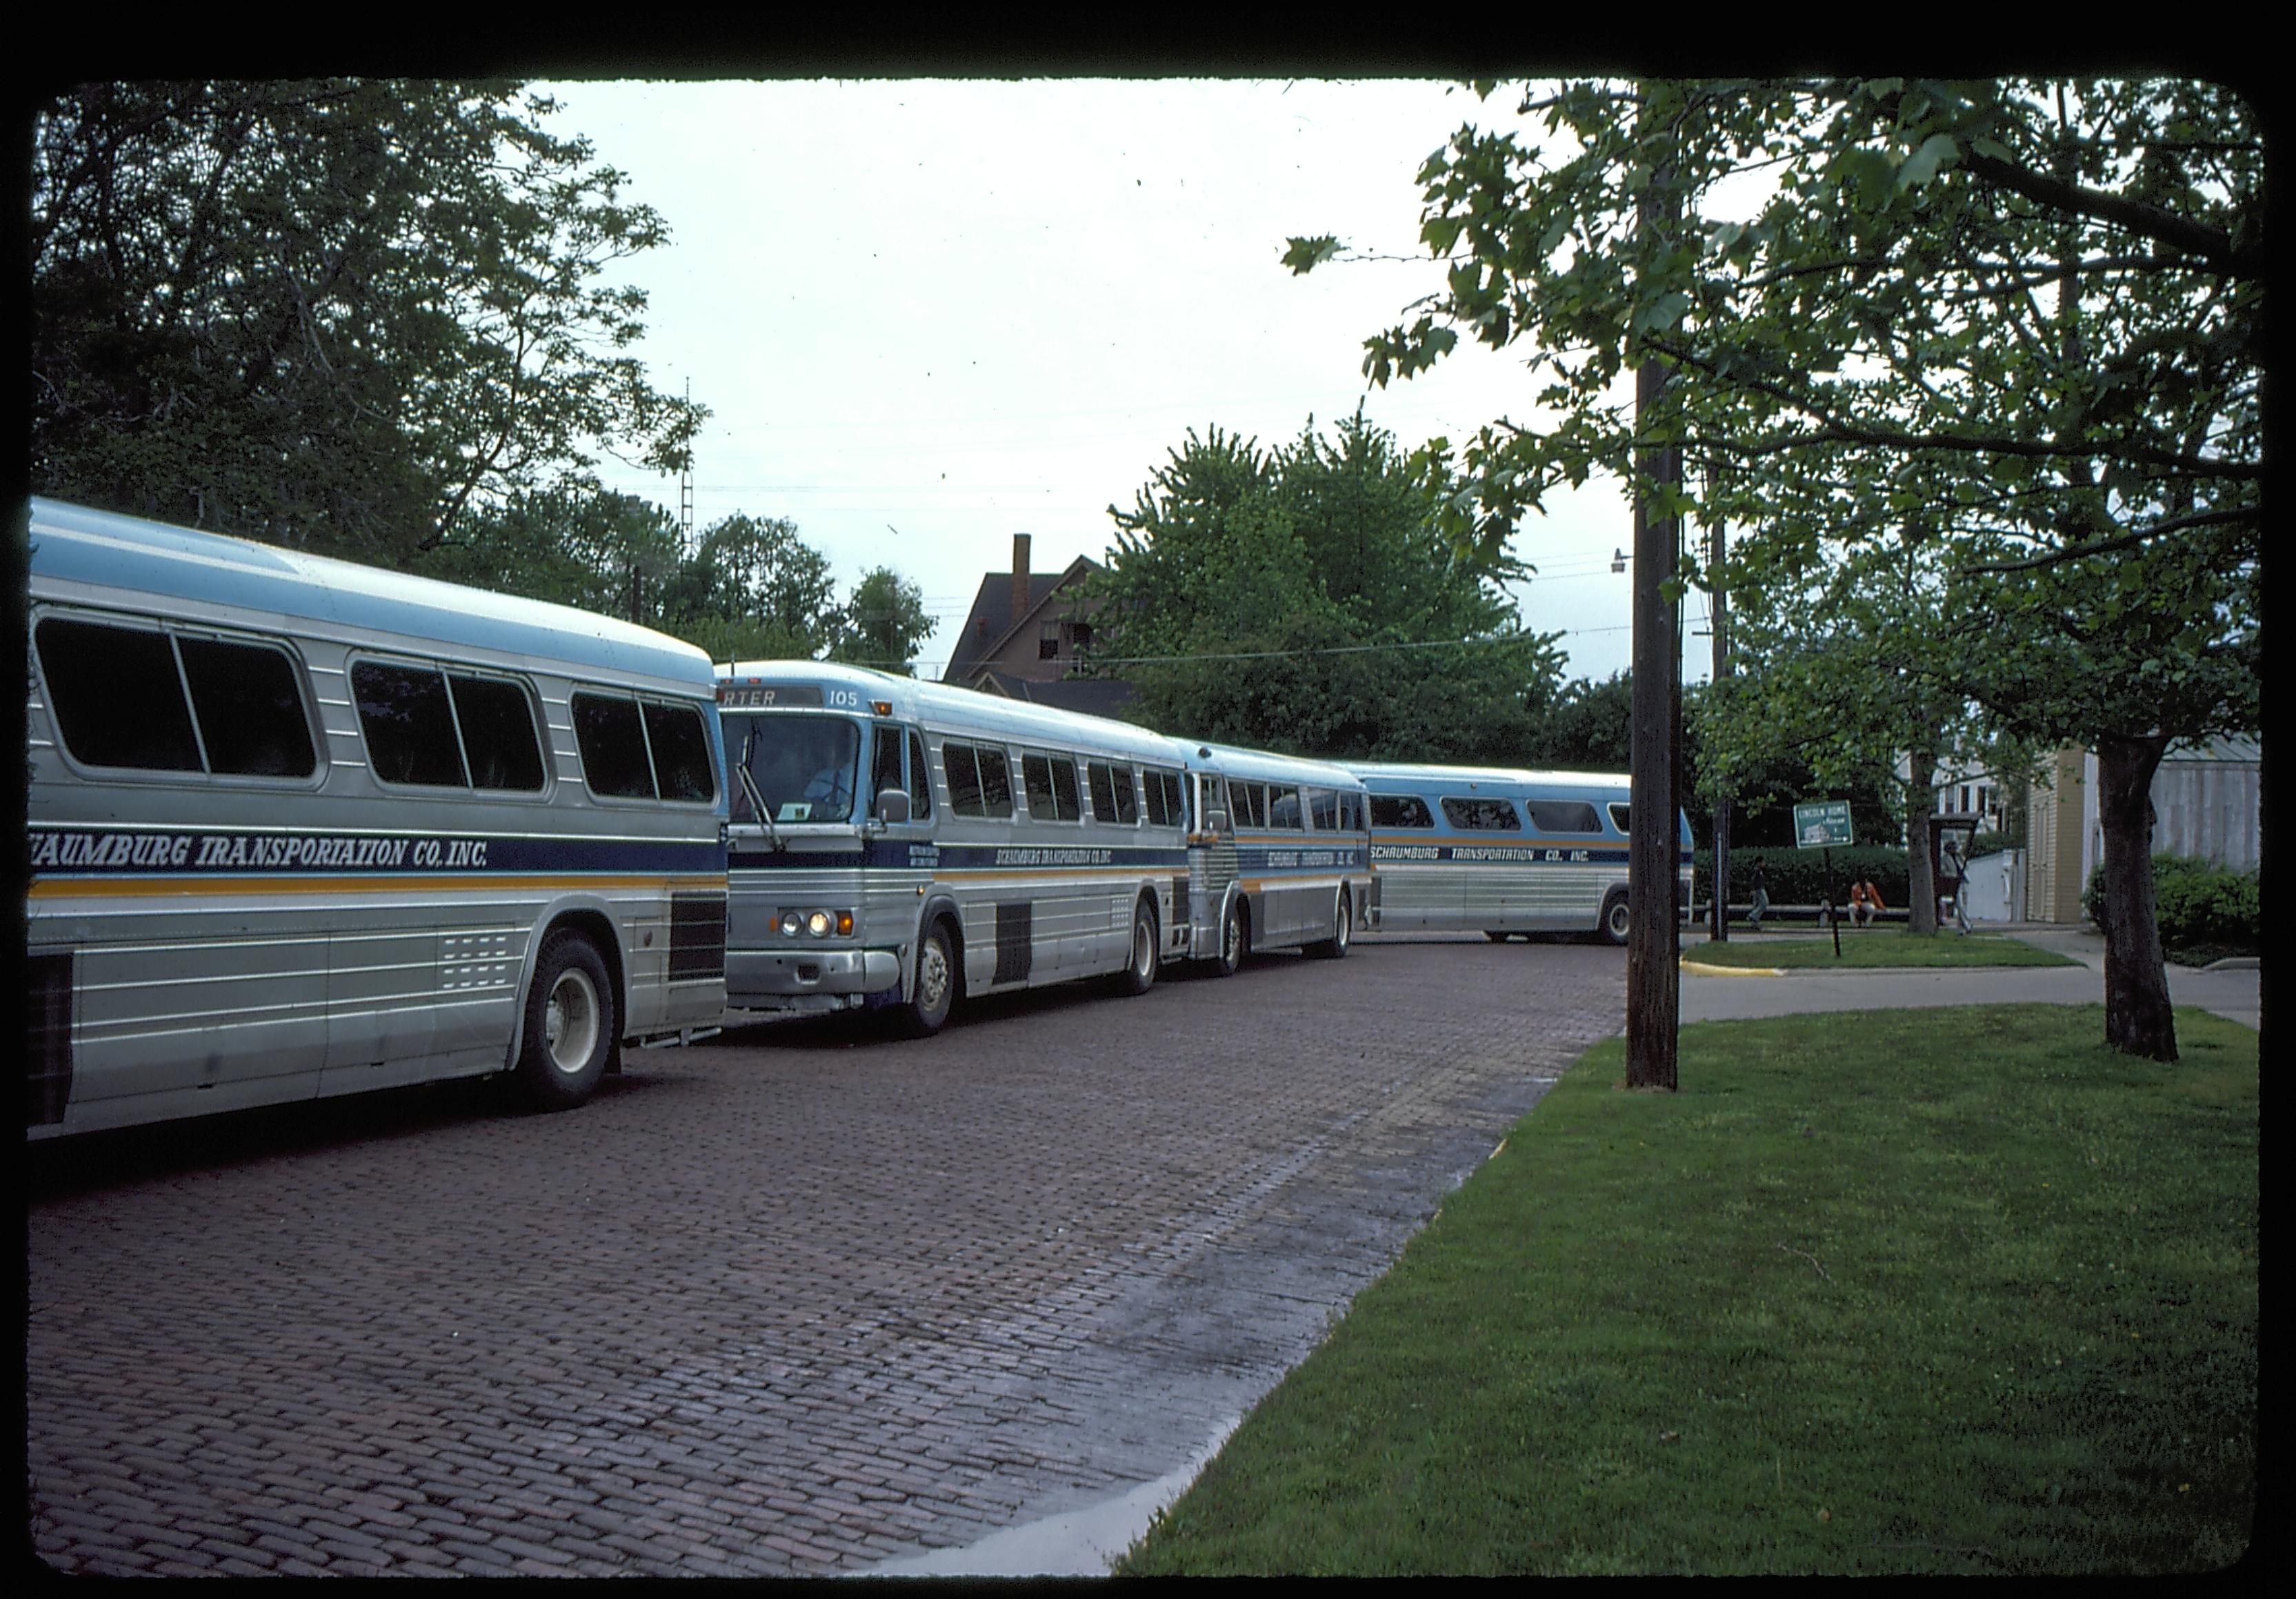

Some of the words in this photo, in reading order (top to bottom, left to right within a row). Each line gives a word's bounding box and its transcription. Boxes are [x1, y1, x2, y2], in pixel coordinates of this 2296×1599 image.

[830, 691, 857, 706] 105
[196, 835, 409, 866] TRANSPORTATION
[1370, 846, 1440, 860] SCHAUMBURG
[1451, 847, 1535, 862] TRANSPORTATION
[1570, 850, 1588, 862] INC.
